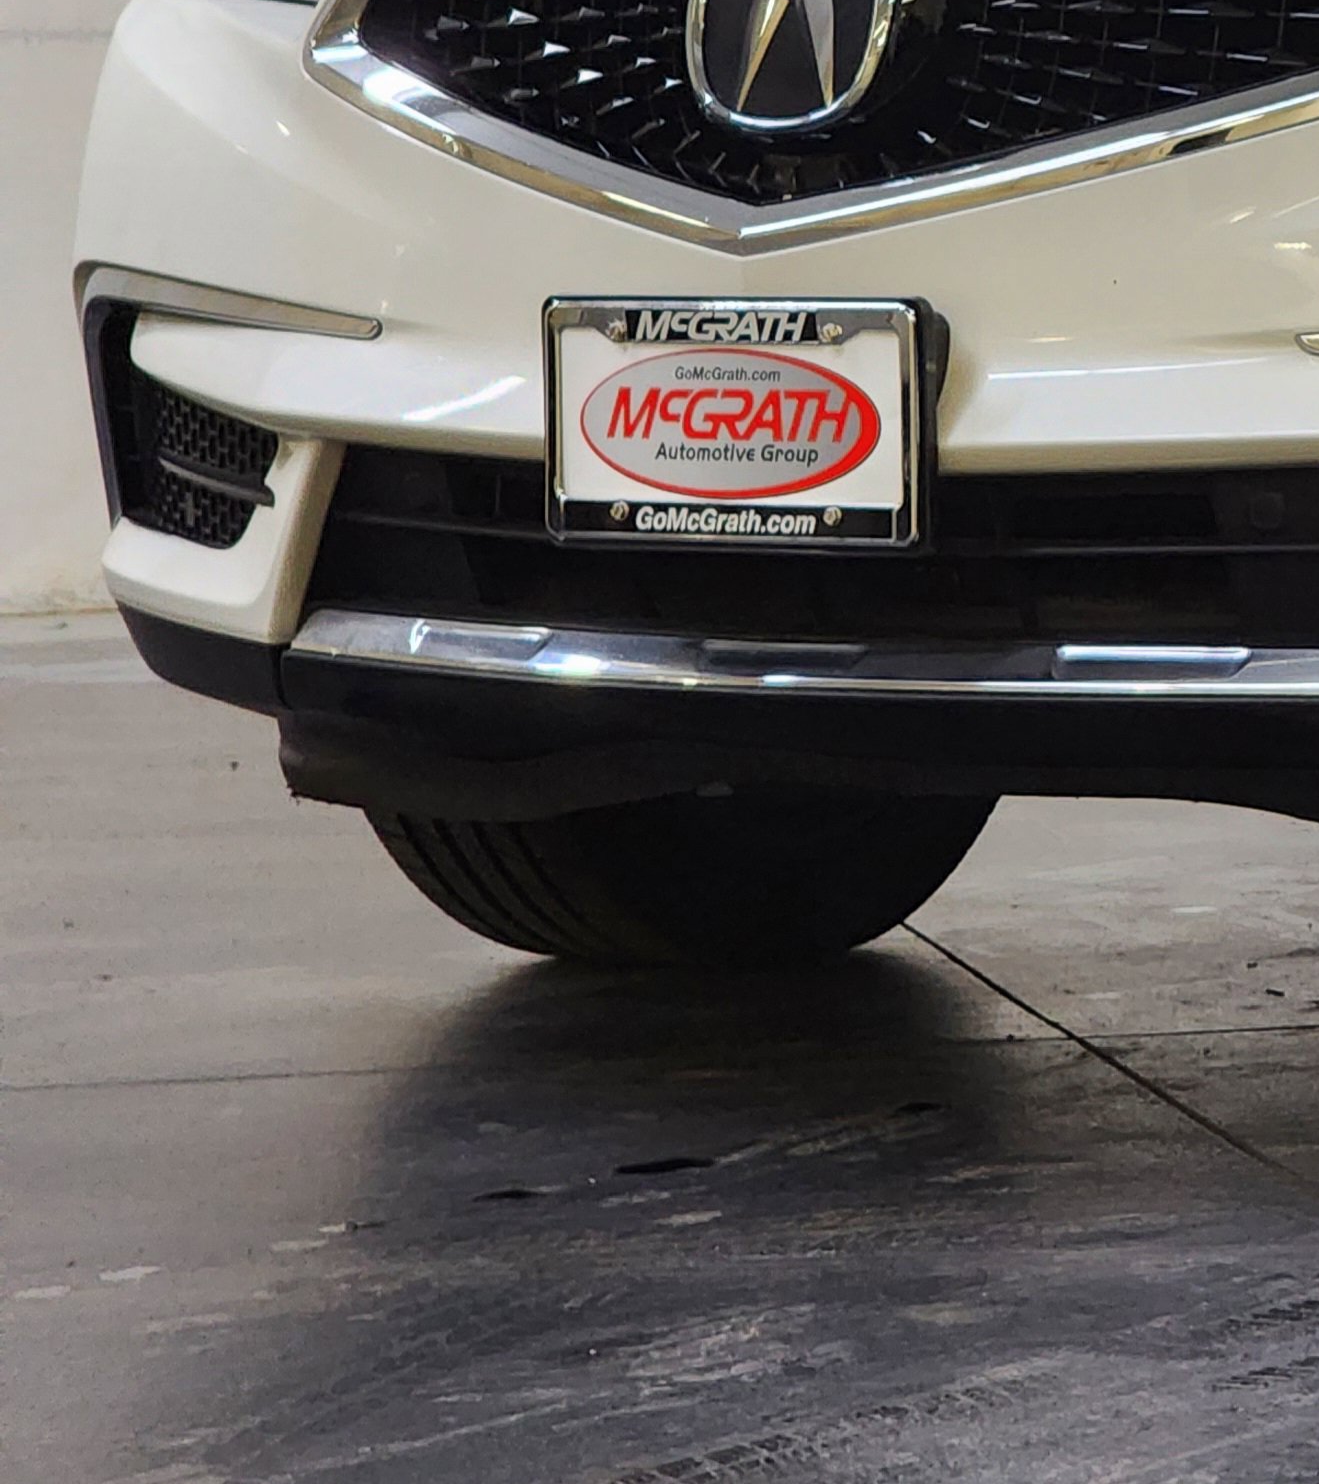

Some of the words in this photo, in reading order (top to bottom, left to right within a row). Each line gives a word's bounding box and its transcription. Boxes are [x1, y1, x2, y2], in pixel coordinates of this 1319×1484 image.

[674, 366, 781, 383] GoMcGrath.com
[655, 441, 756, 463] Automotive
[760, 445, 819, 468] Group
[635, 505, 817, 536] GoMcGrath.com
